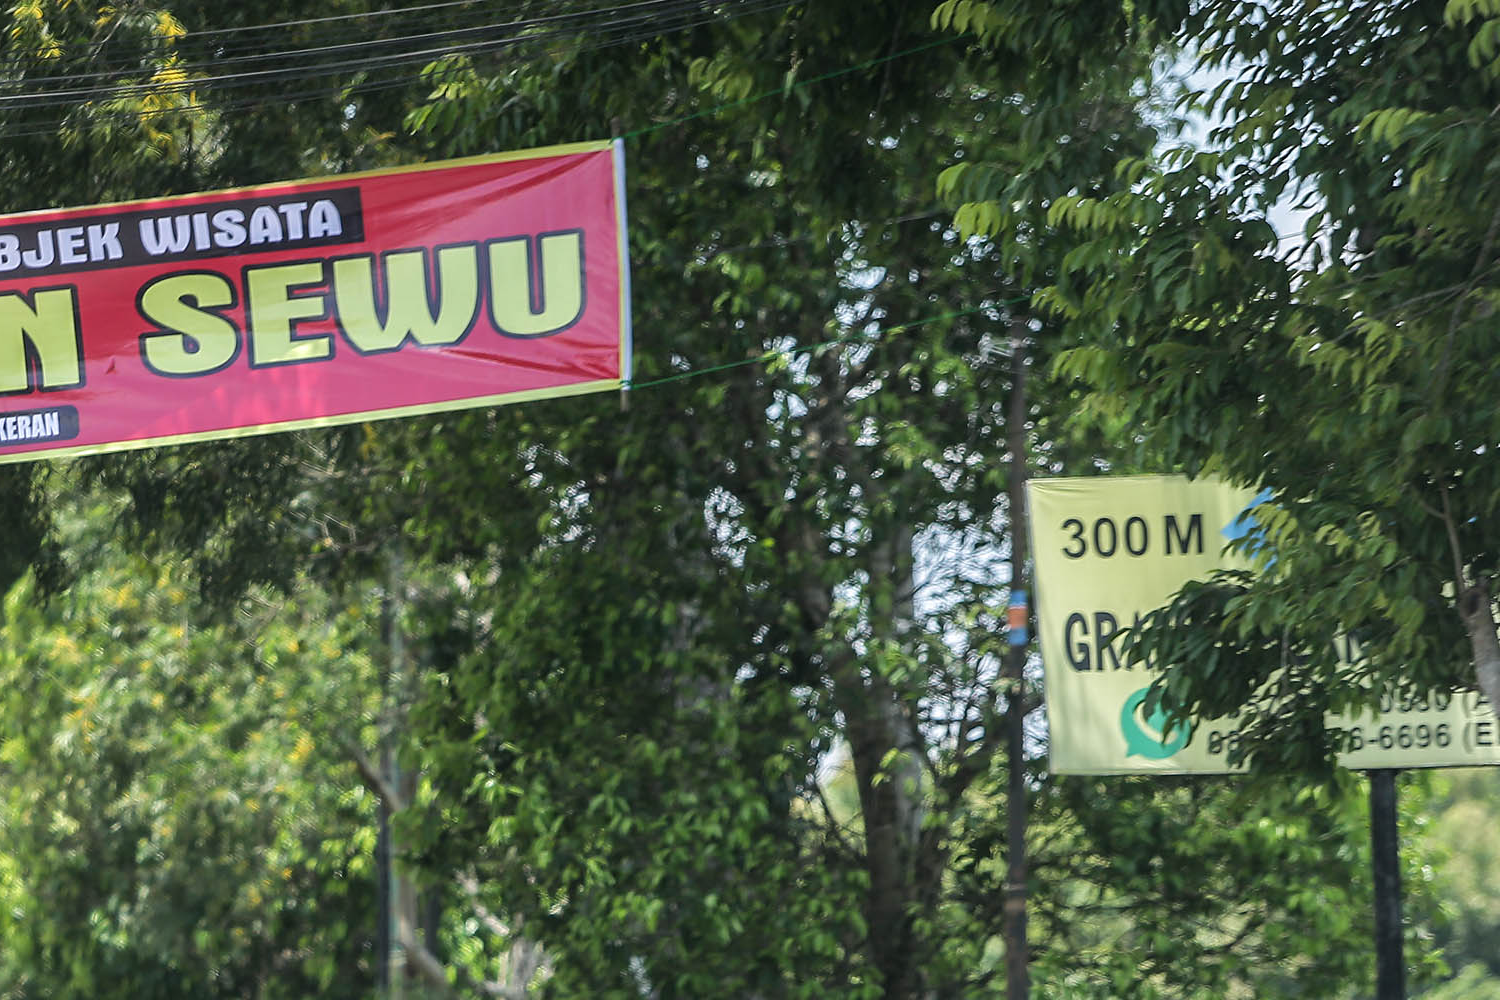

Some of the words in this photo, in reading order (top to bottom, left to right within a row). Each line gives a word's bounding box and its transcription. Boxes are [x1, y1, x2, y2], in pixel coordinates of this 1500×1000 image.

[140, 199, 343, 255] WISATA
[140, 230, 585, 377] SEWU
[1061, 517, 1148, 558] 300
[1165, 513, 1204, 556] M
